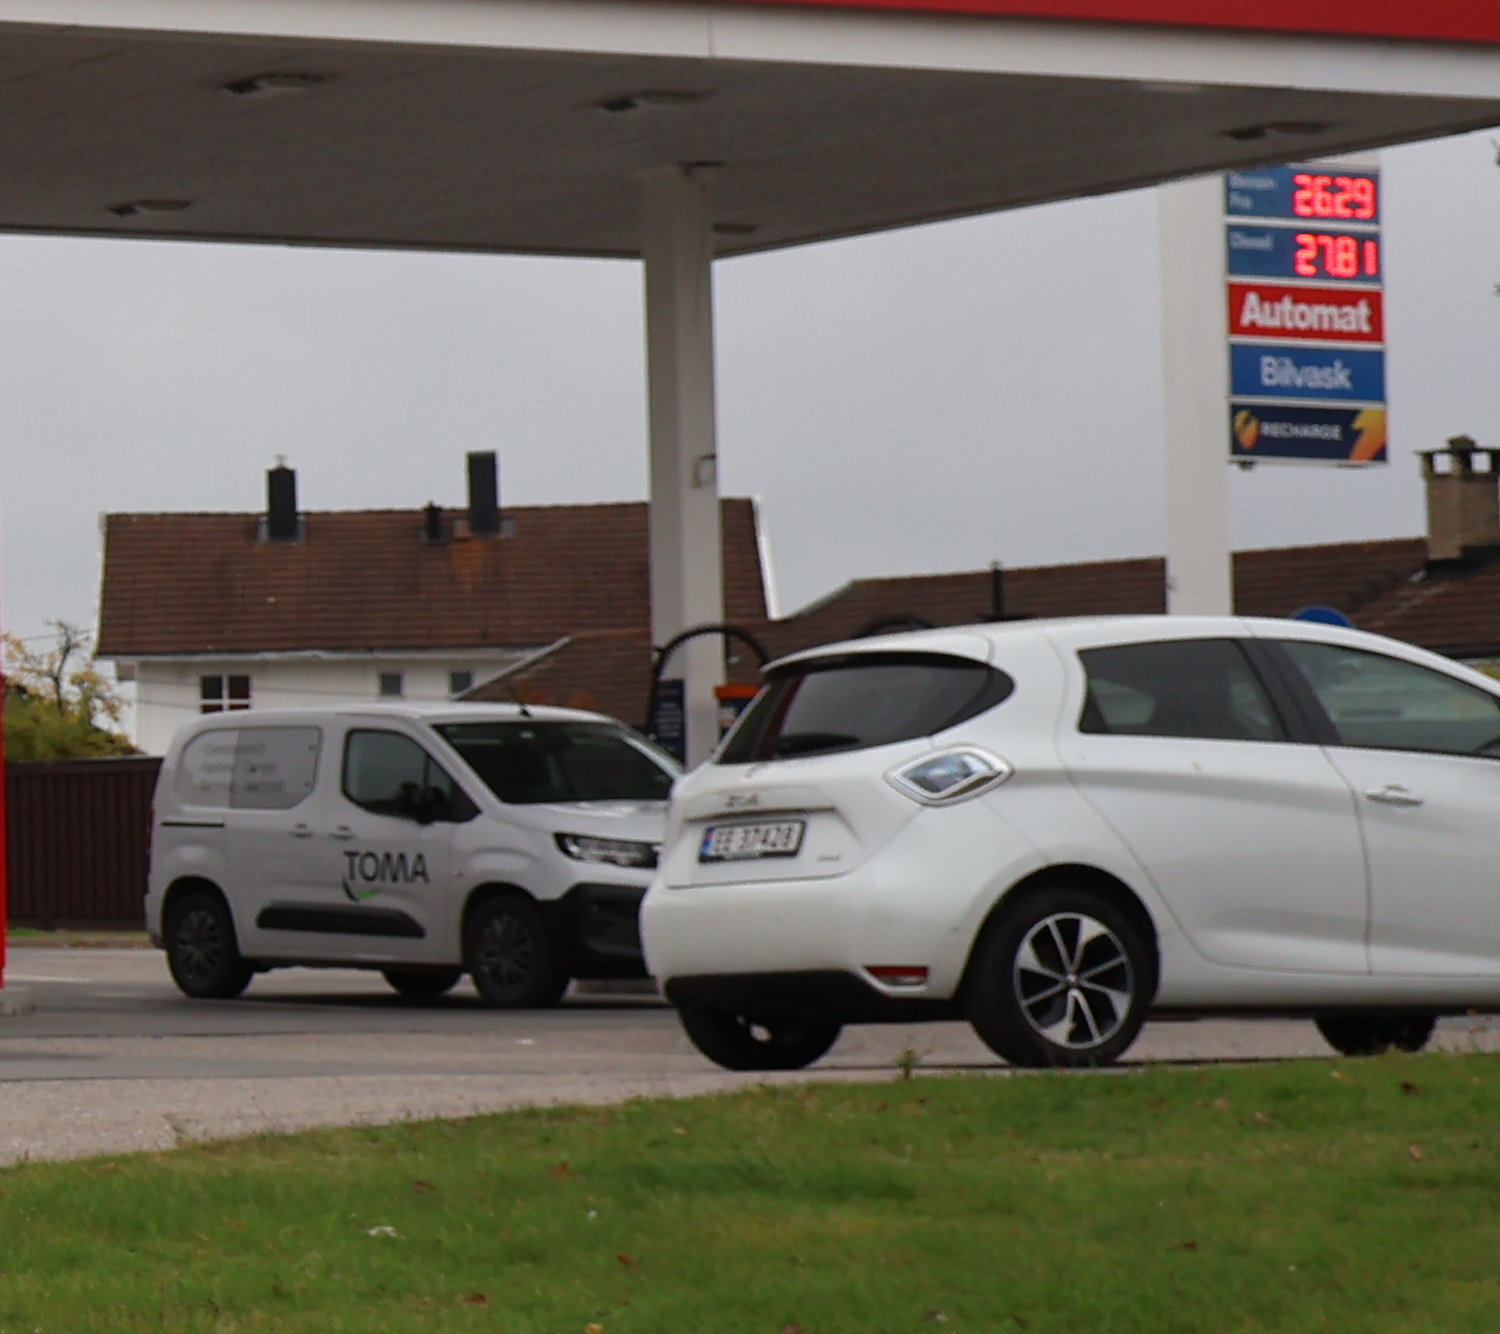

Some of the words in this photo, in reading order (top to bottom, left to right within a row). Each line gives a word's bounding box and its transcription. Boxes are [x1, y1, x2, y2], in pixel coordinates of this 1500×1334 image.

[1240, 291, 1373, 334] Automat
[1260, 355, 1353, 390] Bilvask
[343, 851, 431, 884] TOMA
